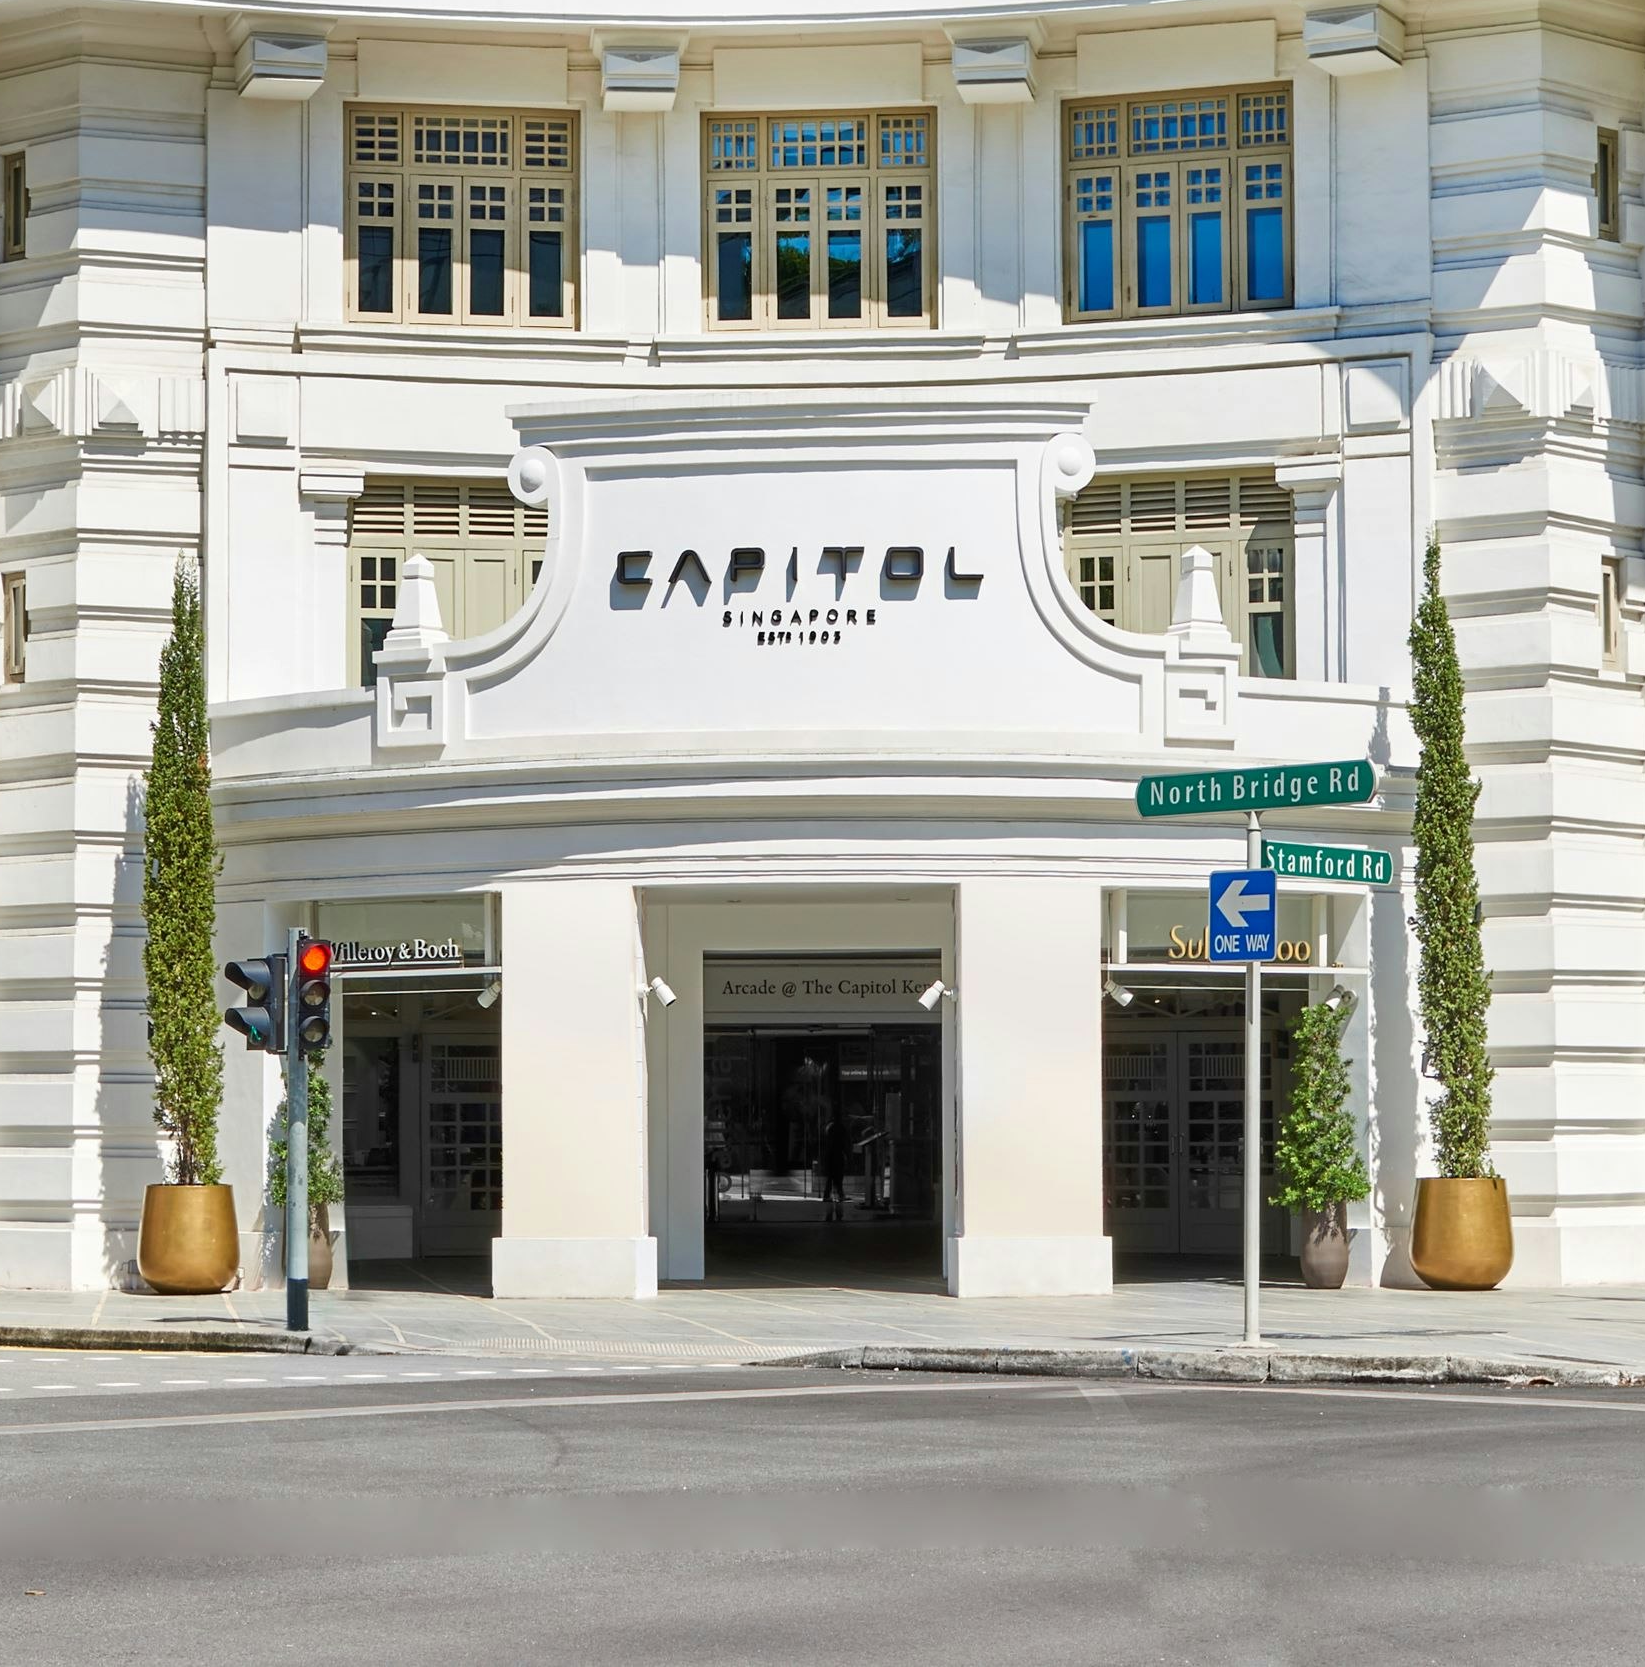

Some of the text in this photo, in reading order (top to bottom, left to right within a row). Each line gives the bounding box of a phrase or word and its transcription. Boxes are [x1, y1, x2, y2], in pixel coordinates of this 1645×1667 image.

[617, 546, 985, 585] CAPITOL
[722, 608, 876, 626] SINGAPORE
[1150, 766, 1360, 806] North Bridge Rd
[1265, 845, 1385, 881] Stamford Rd
[330, 938, 459, 965] Villeroy & Boch
[1214, 933, 1271, 954] ONE WAY
[722, 979, 776, 995] Arcade
[781, 982, 797, 998] @
[802, 979, 833, 995] The
[837, 979, 897, 998] Capitol
